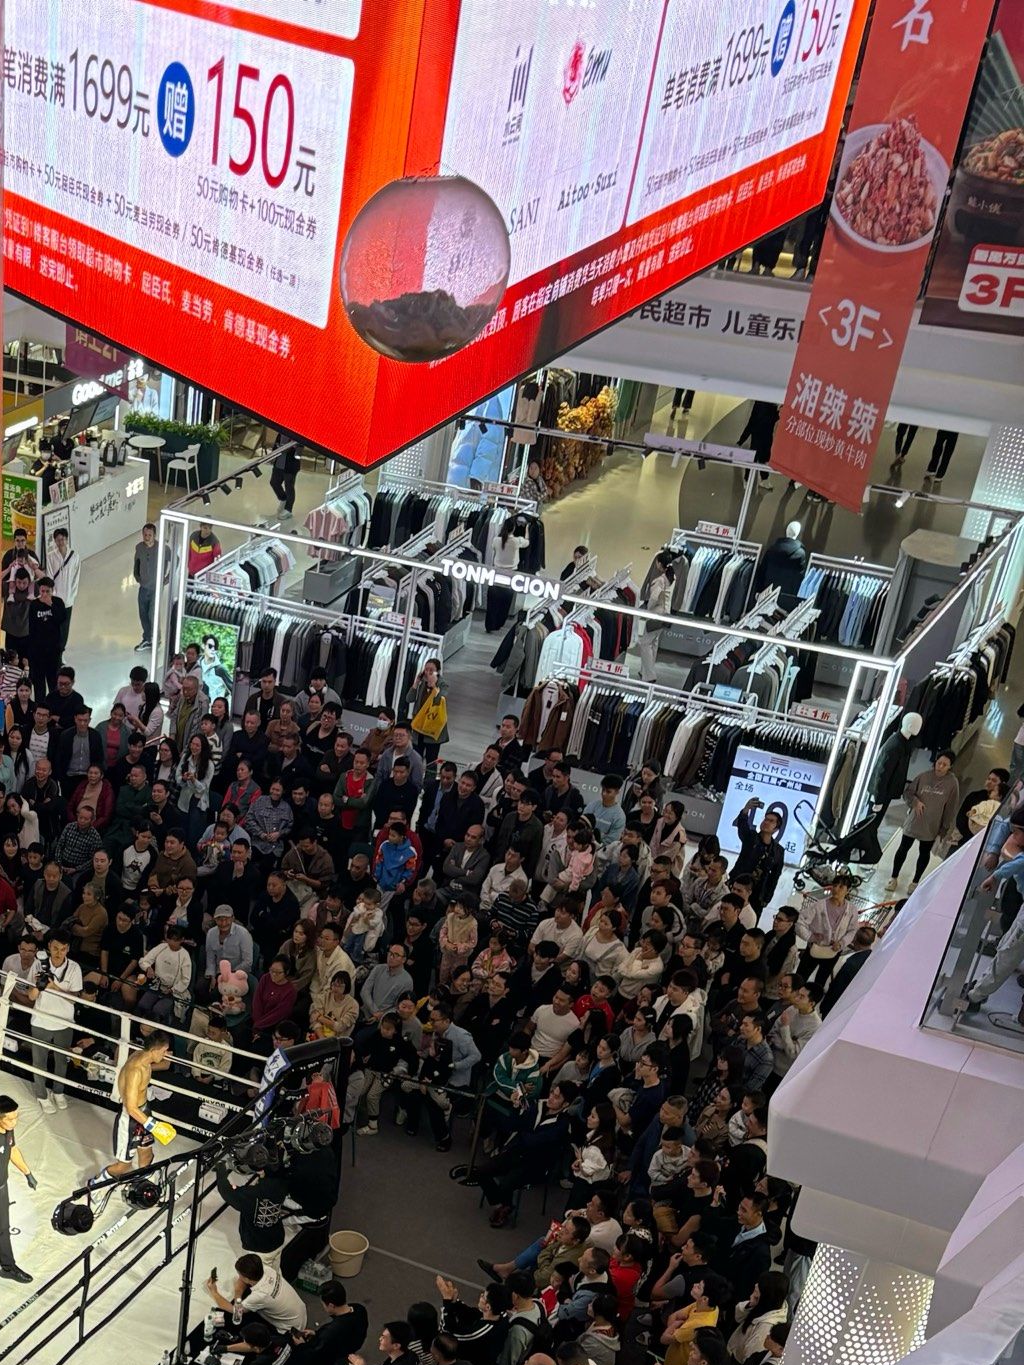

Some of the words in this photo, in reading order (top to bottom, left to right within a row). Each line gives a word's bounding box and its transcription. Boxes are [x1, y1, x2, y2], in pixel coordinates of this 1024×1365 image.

[163, 81, 189, 143] 赠
[207, 54, 318, 198] 150元
[631, 298, 712, 330] 民超市
[721, 308, 805, 343] 儿童乐
[791, 372, 879, 446] 湘辣辣
[784, 415, 868, 470] 分部位现炒黄牛肉
[734, 781, 754, 793] 全场
